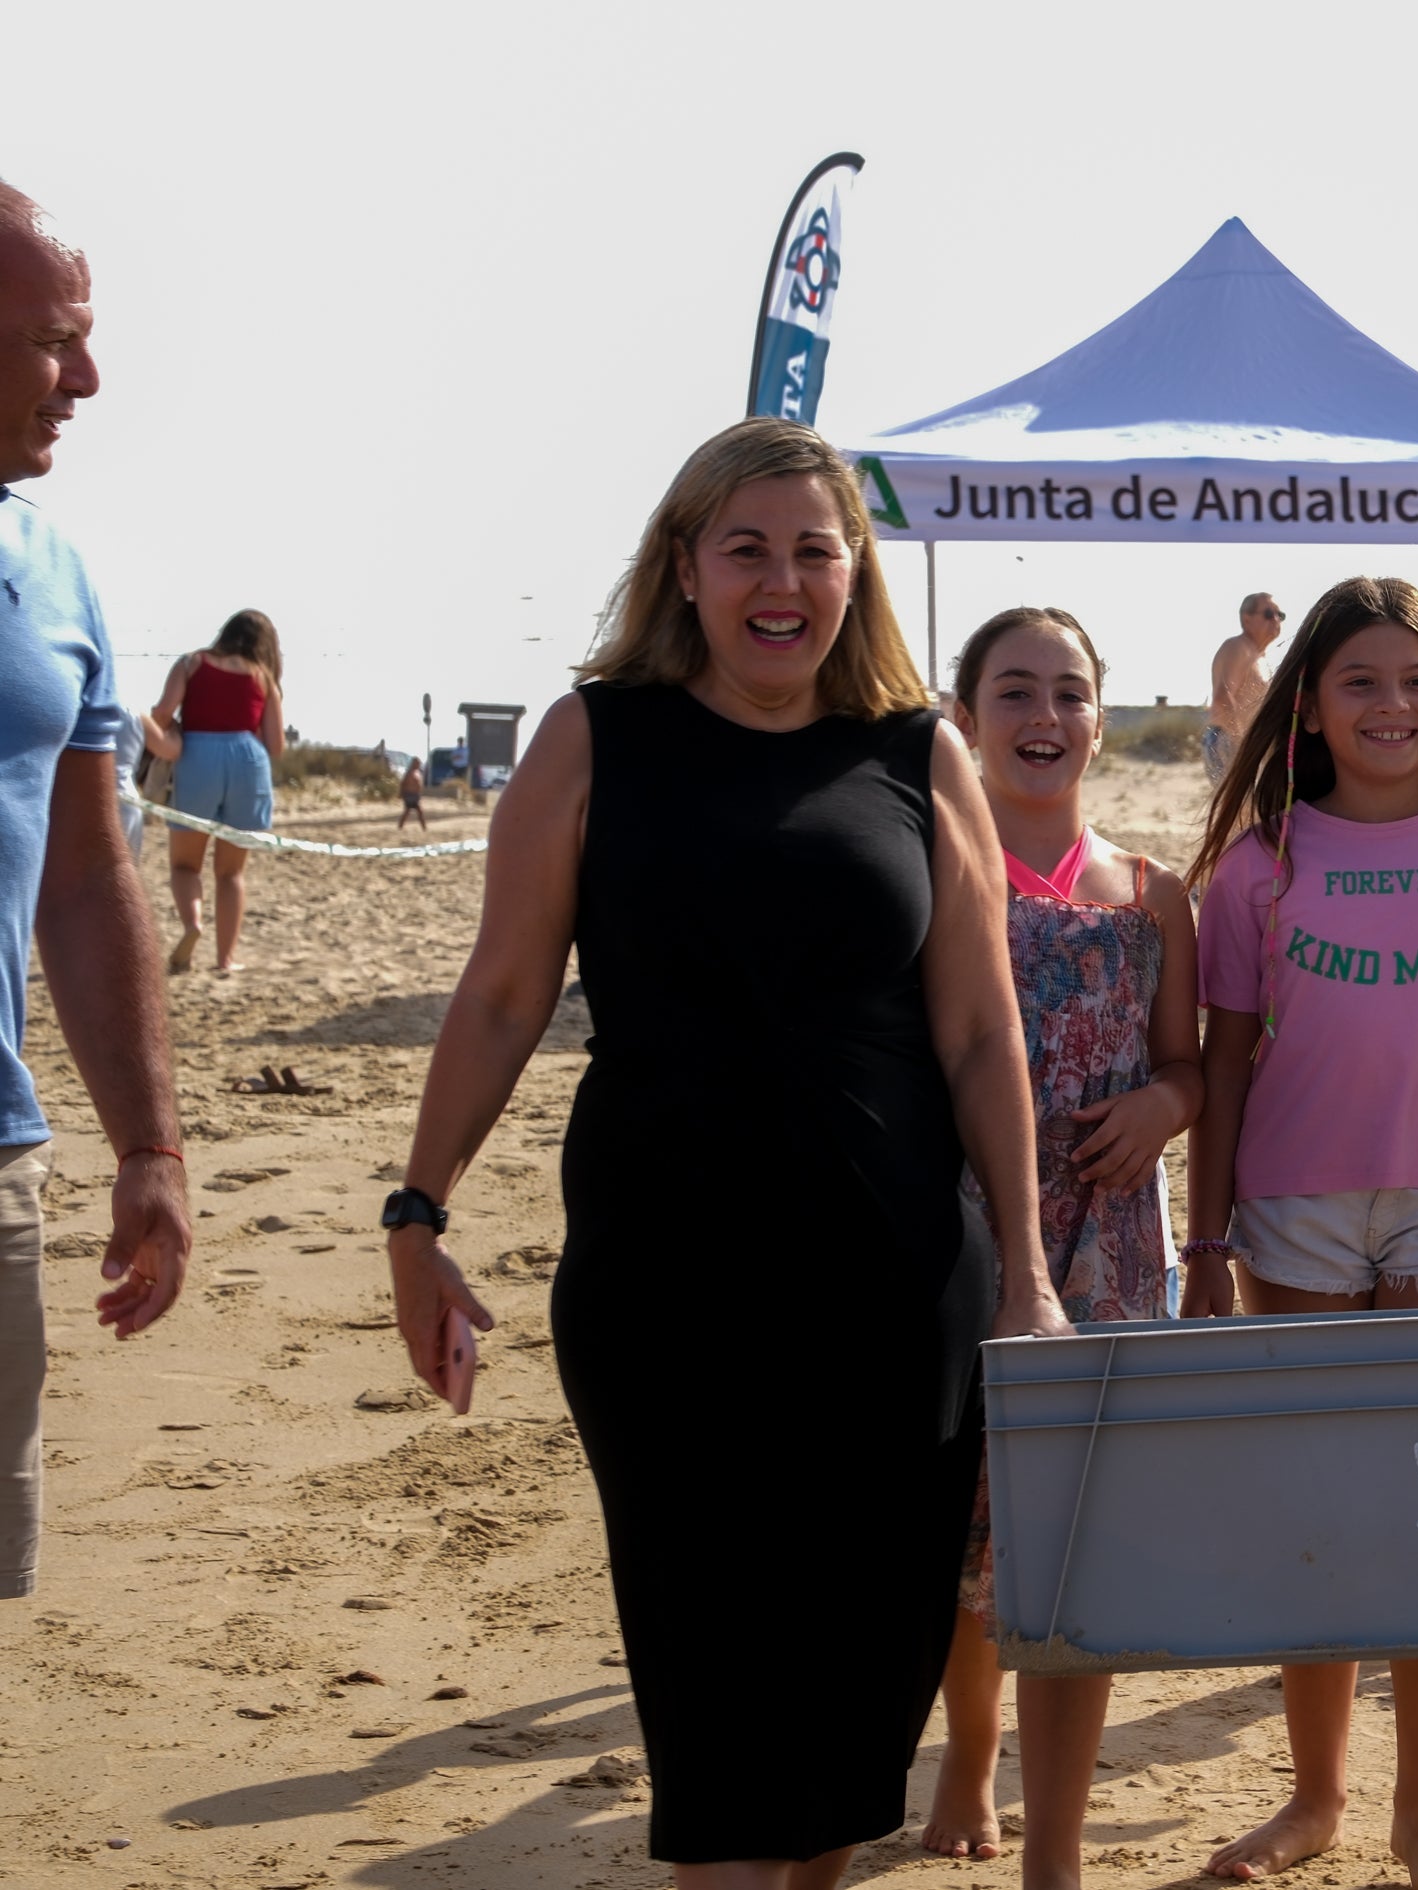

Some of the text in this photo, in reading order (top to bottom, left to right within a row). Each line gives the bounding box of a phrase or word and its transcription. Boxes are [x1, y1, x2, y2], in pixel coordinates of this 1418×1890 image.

[933, 474, 1093, 522] Junta
[1110, 473, 1178, 522] de
[1285, 925, 1381, 986] KIND
